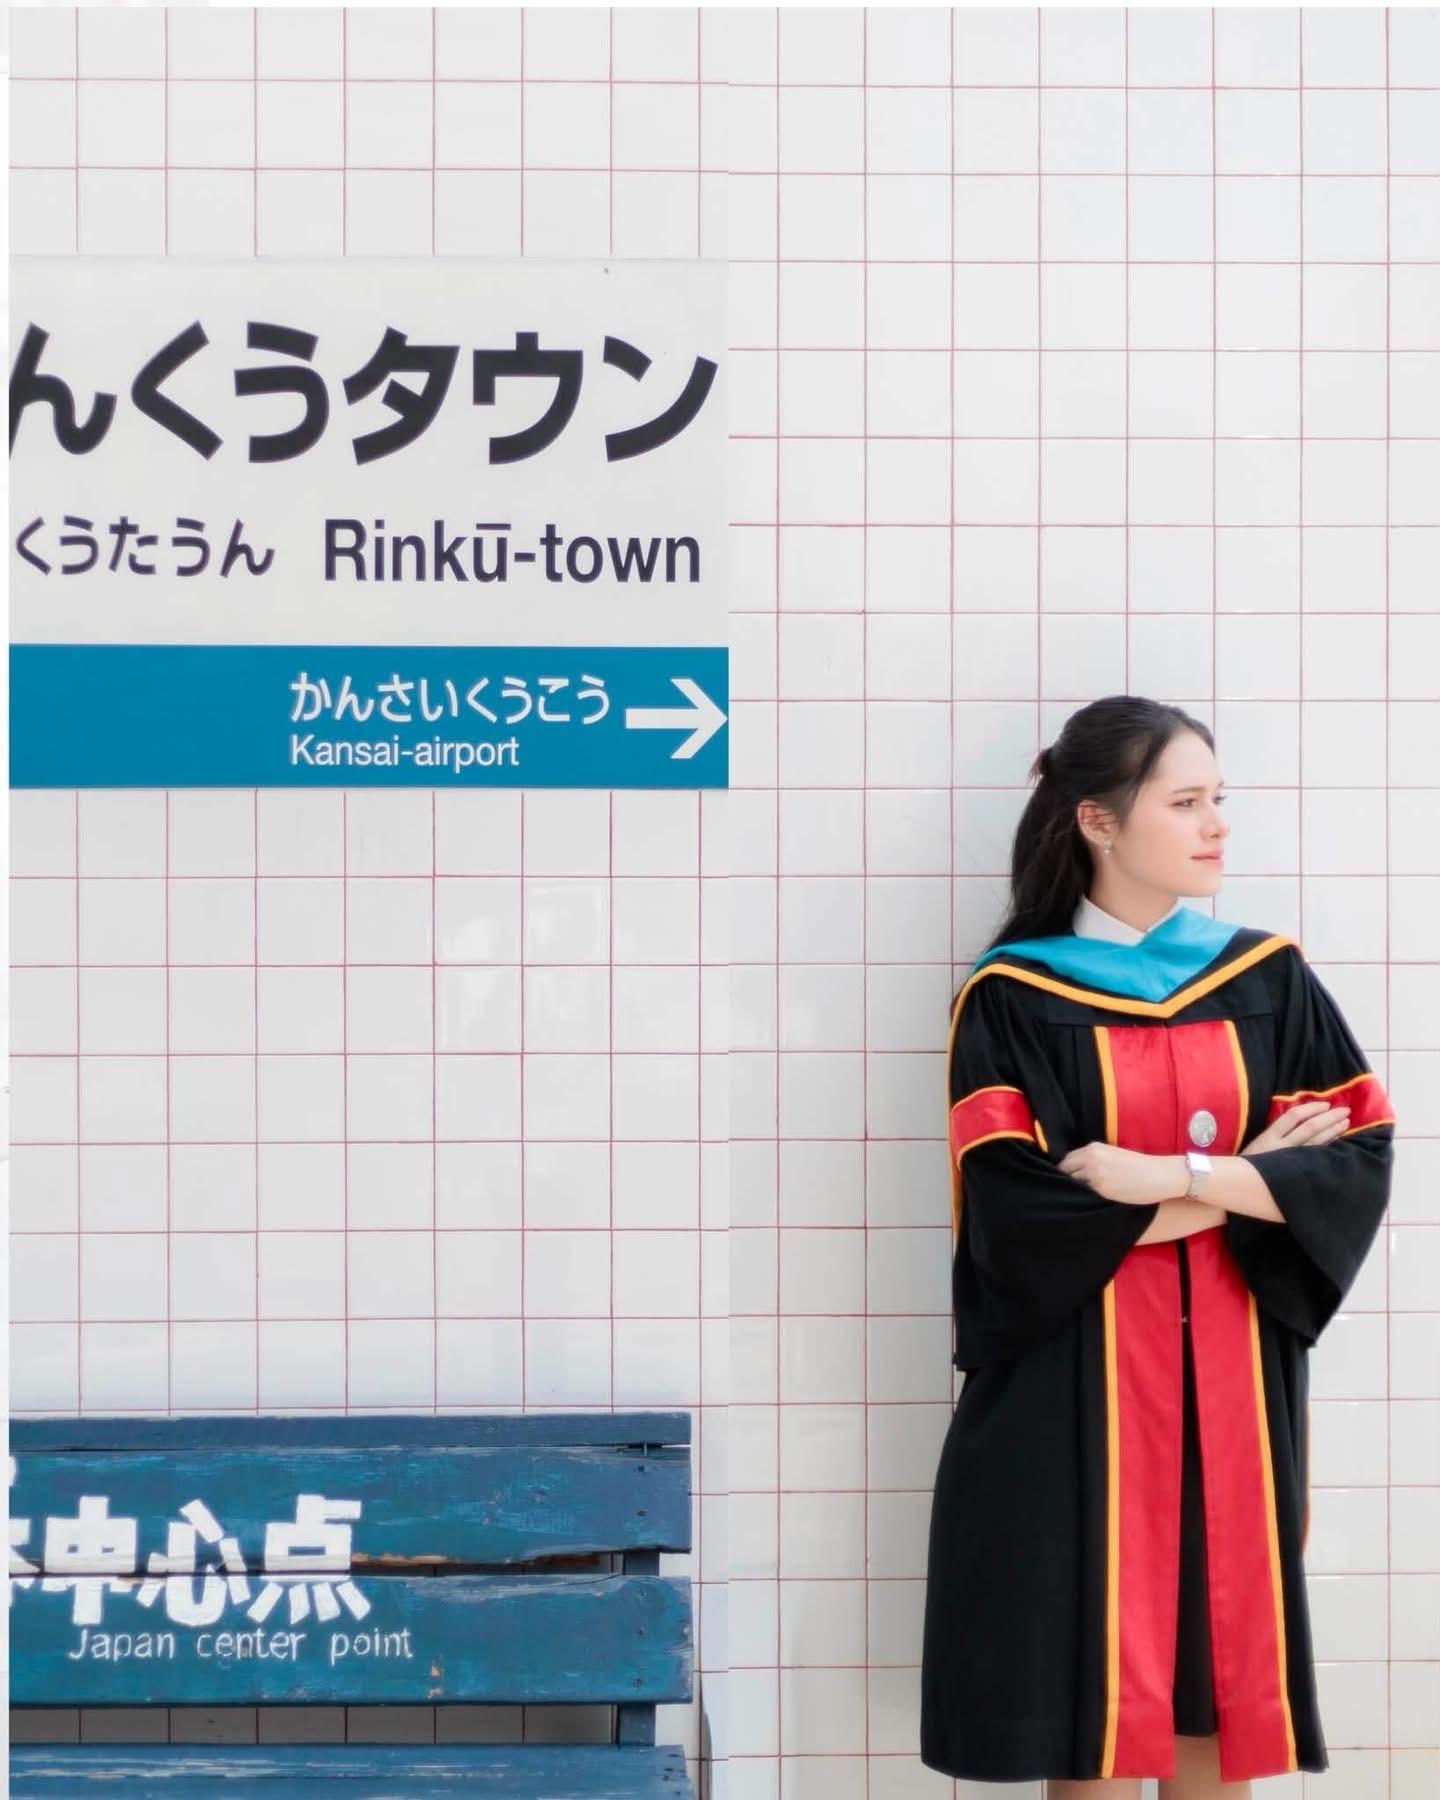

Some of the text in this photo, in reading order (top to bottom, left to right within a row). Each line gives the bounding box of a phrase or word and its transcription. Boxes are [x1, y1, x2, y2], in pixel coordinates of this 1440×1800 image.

[15, 514, 276, 579] くうたうん
[324, 518, 701, 584] Rinkū-town
[290, 671, 611, 725] かんさいくうこう
[290, 733, 520, 774] Kansai-airport
[68, 1626, 415, 1666] Japan center point
